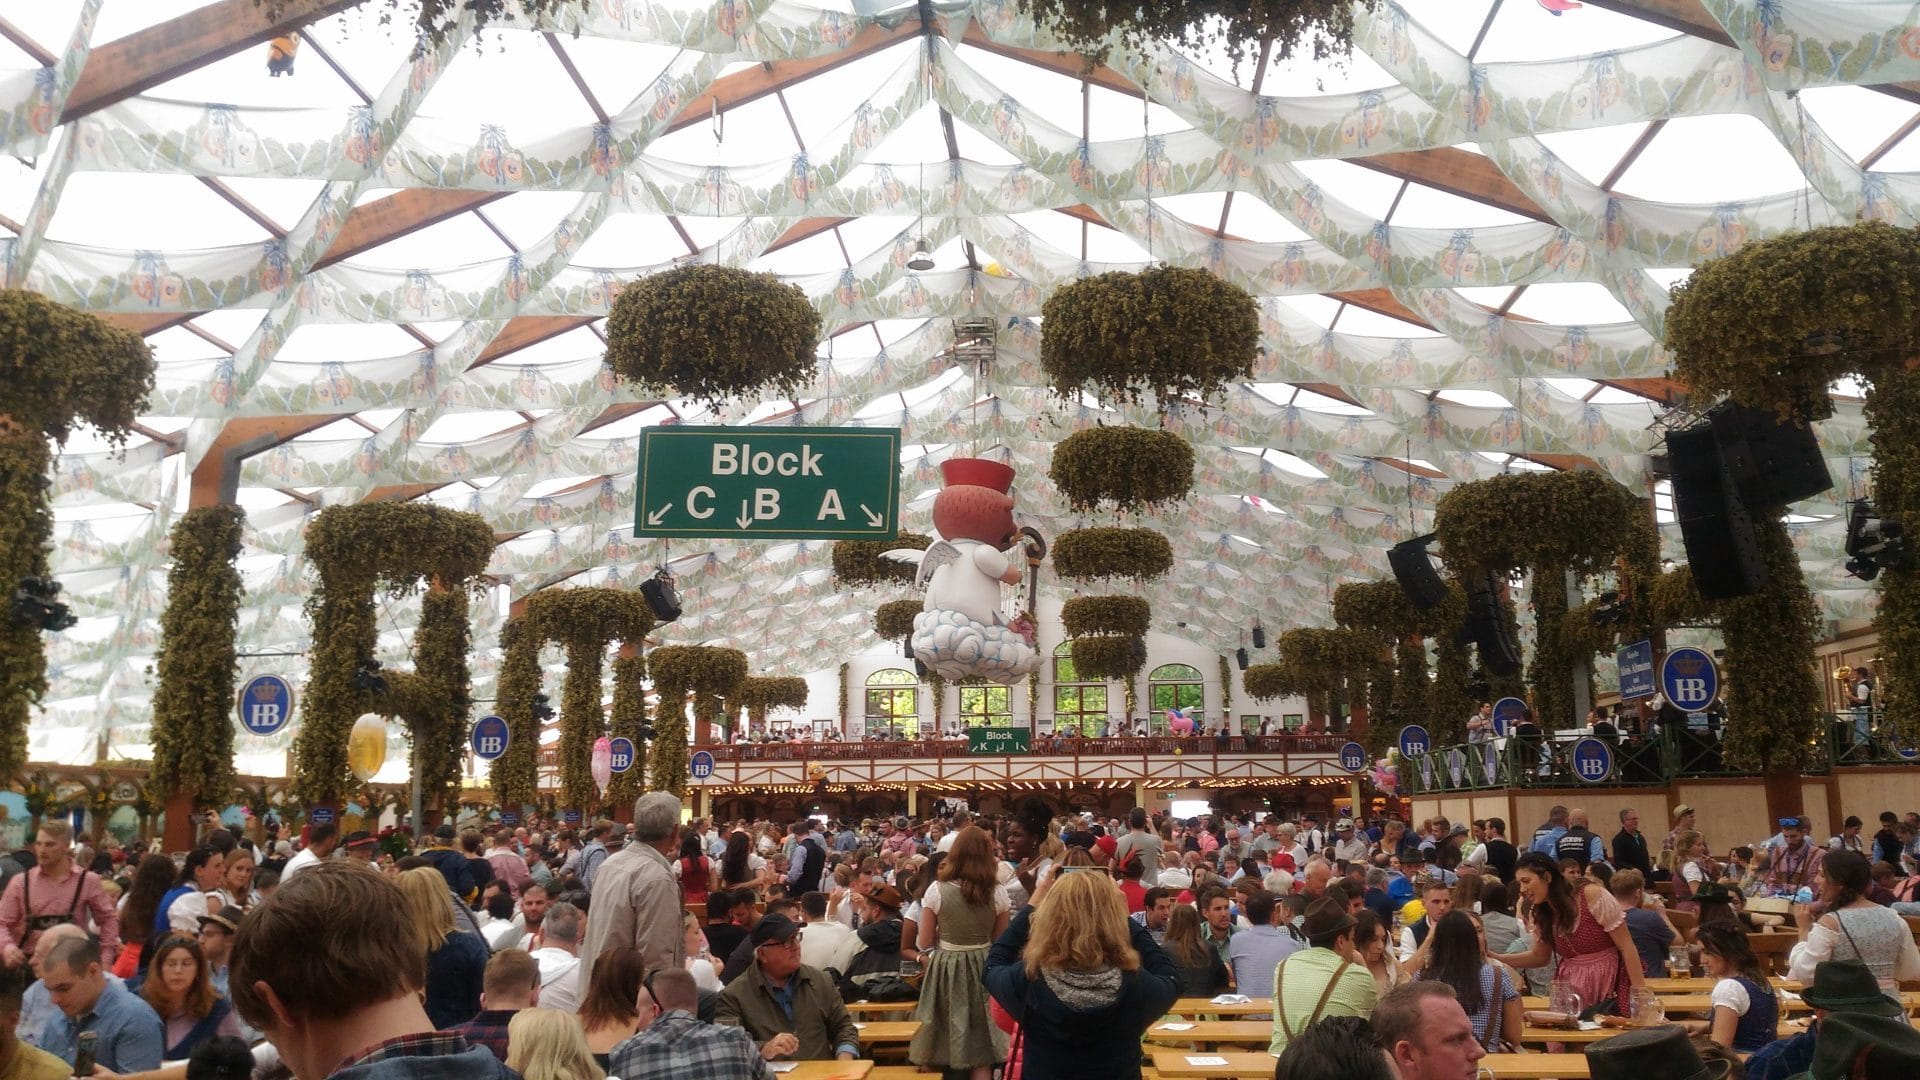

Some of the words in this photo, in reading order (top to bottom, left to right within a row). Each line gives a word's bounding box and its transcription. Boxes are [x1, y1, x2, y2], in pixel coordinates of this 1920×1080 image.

[711, 442, 824, 477] Block
[686, 485, 717, 520] C
[754, 487, 782, 521] B
[816, 488, 846, 521] A
[1674, 678, 1708, 702] HB
[251, 703, 280, 727] HB
[986, 731, 1013, 740] Block
[480, 736, 502, 754] HB
[980, 741, 988, 751] K
[999, 741, 1005, 751] J
[1015, 741, 1019, 751] I
[1406, 742, 1425, 756] HB
[611, 754, 629, 768] HB
[1346, 756, 1361, 768] HB
[1582, 758, 1604, 775] HB
[695, 764, 709, 776] HB
